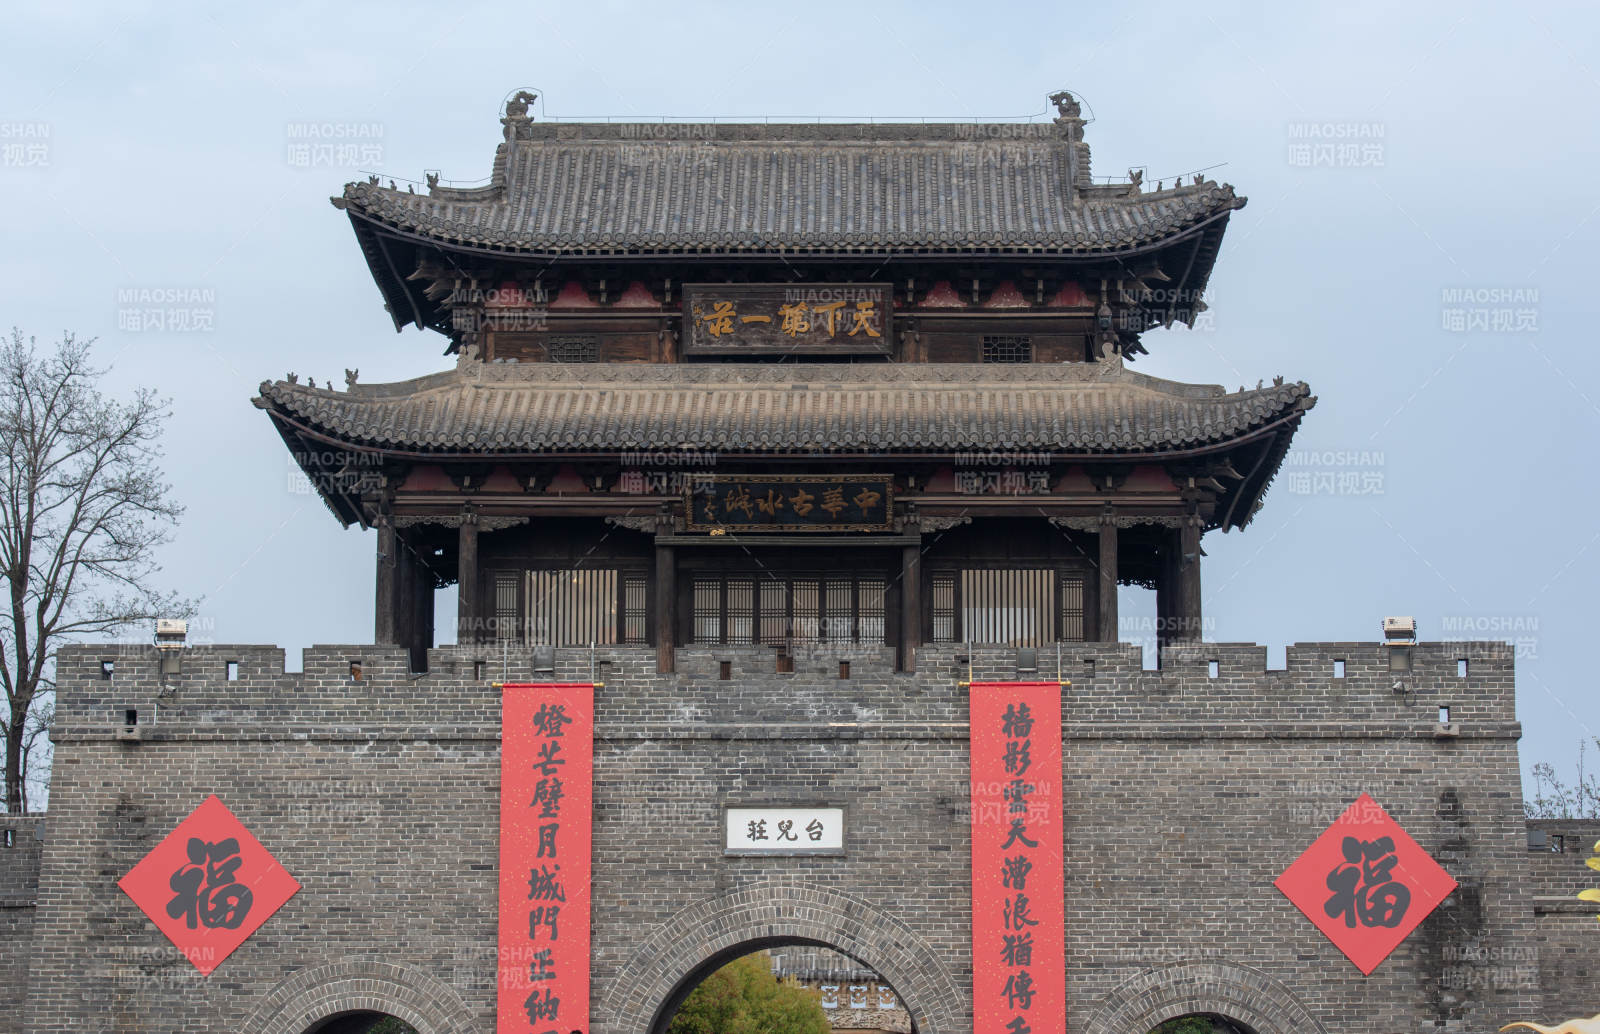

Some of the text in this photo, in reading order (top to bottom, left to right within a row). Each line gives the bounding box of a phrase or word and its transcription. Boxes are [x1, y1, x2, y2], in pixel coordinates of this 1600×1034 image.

[166, 837, 254, 930] 福
[524, 703, 573, 1034] 燈芒璧月城門正納
[1323, 835, 1412, 929] 福
